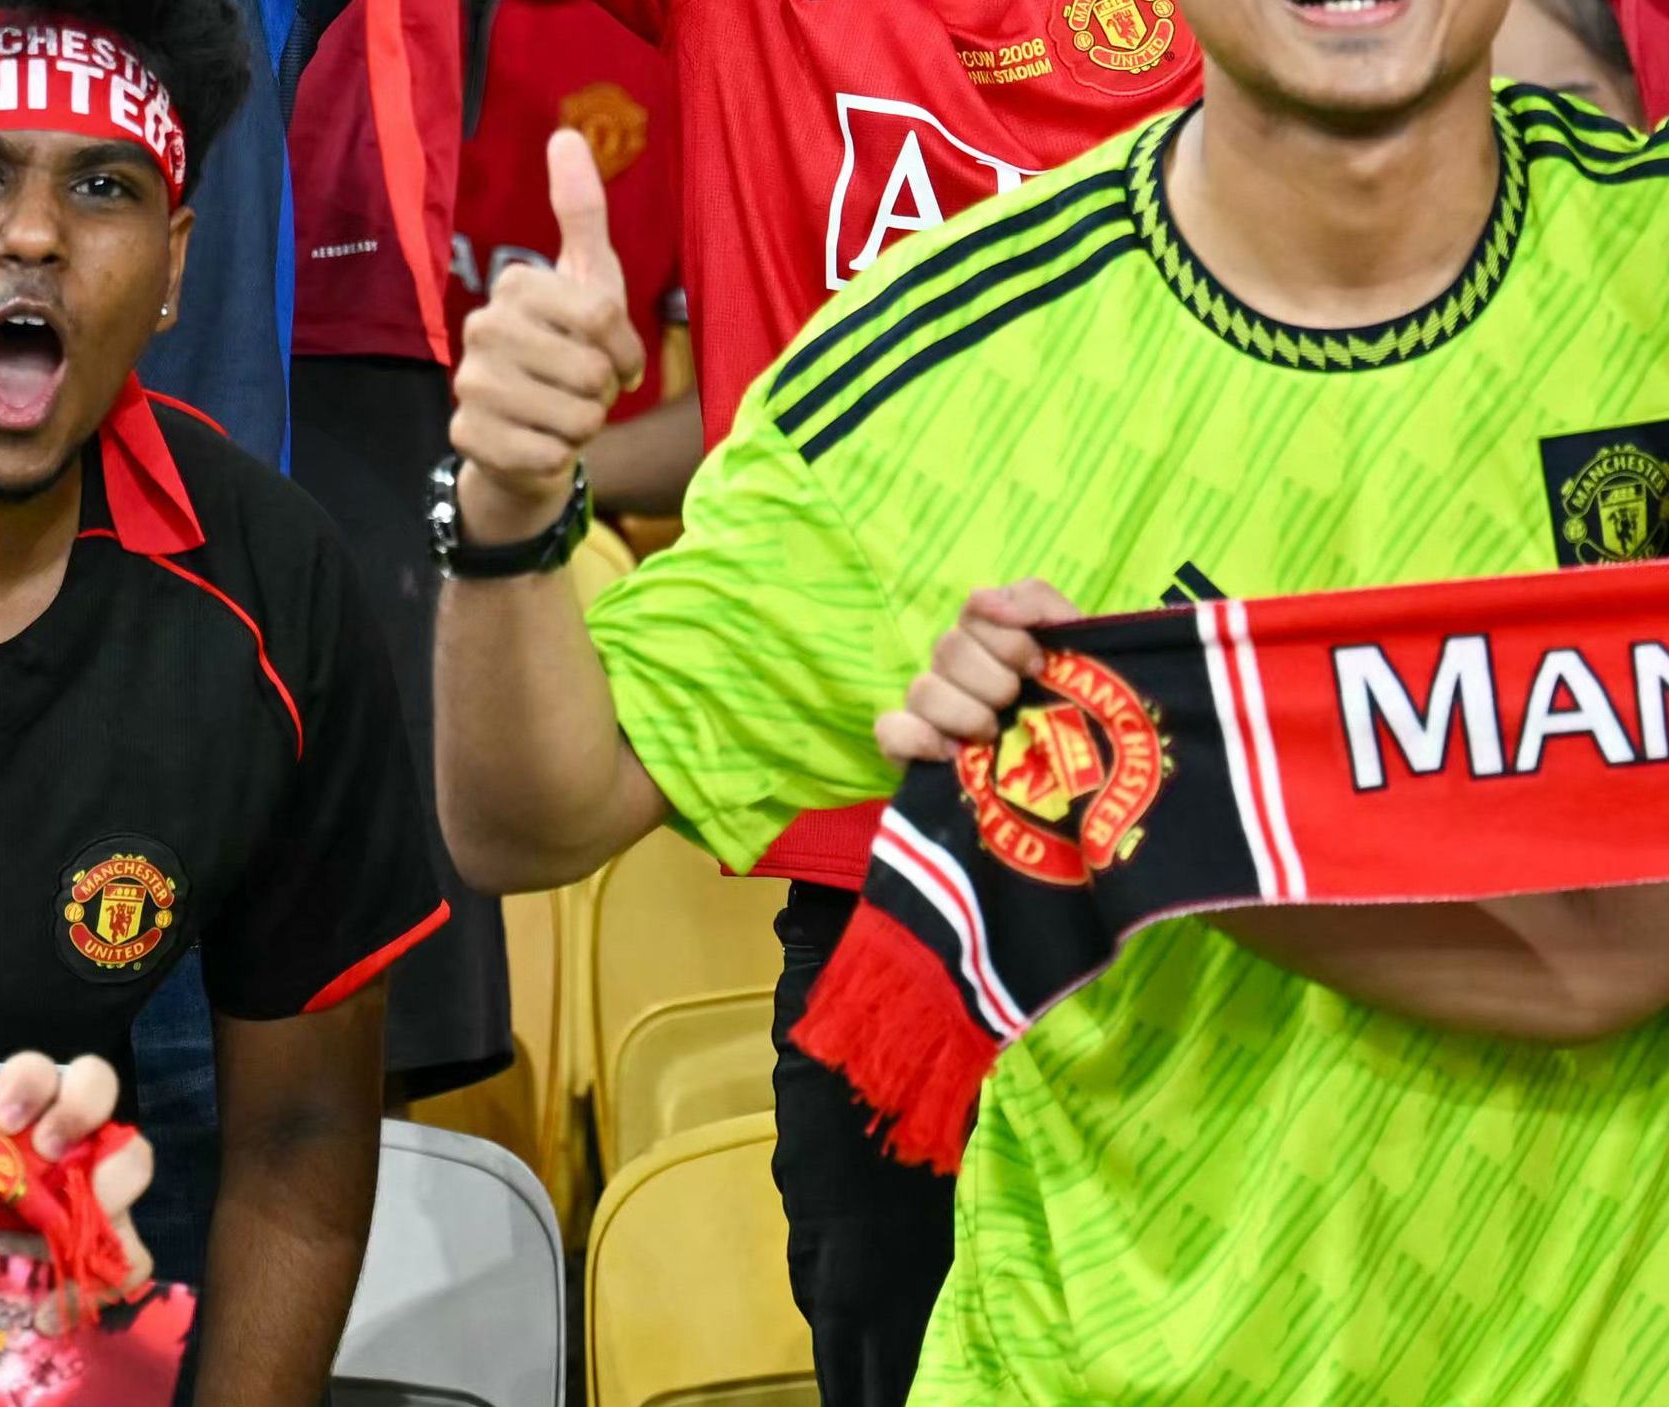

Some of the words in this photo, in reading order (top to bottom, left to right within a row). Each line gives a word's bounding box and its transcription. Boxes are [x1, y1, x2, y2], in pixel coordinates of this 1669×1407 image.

[999, 38, 1046, 67] 2008
[1110, 37, 1165, 67] UNITED
[994, 57, 1053, 85] STADIUM
[1572, 455, 1667, 510] MANCHESTER
[1046, 653, 1150, 847] MANCHESTER
[80, 862, 168, 903] MANCHESTER
[85, 939, 145, 960] UNITED
